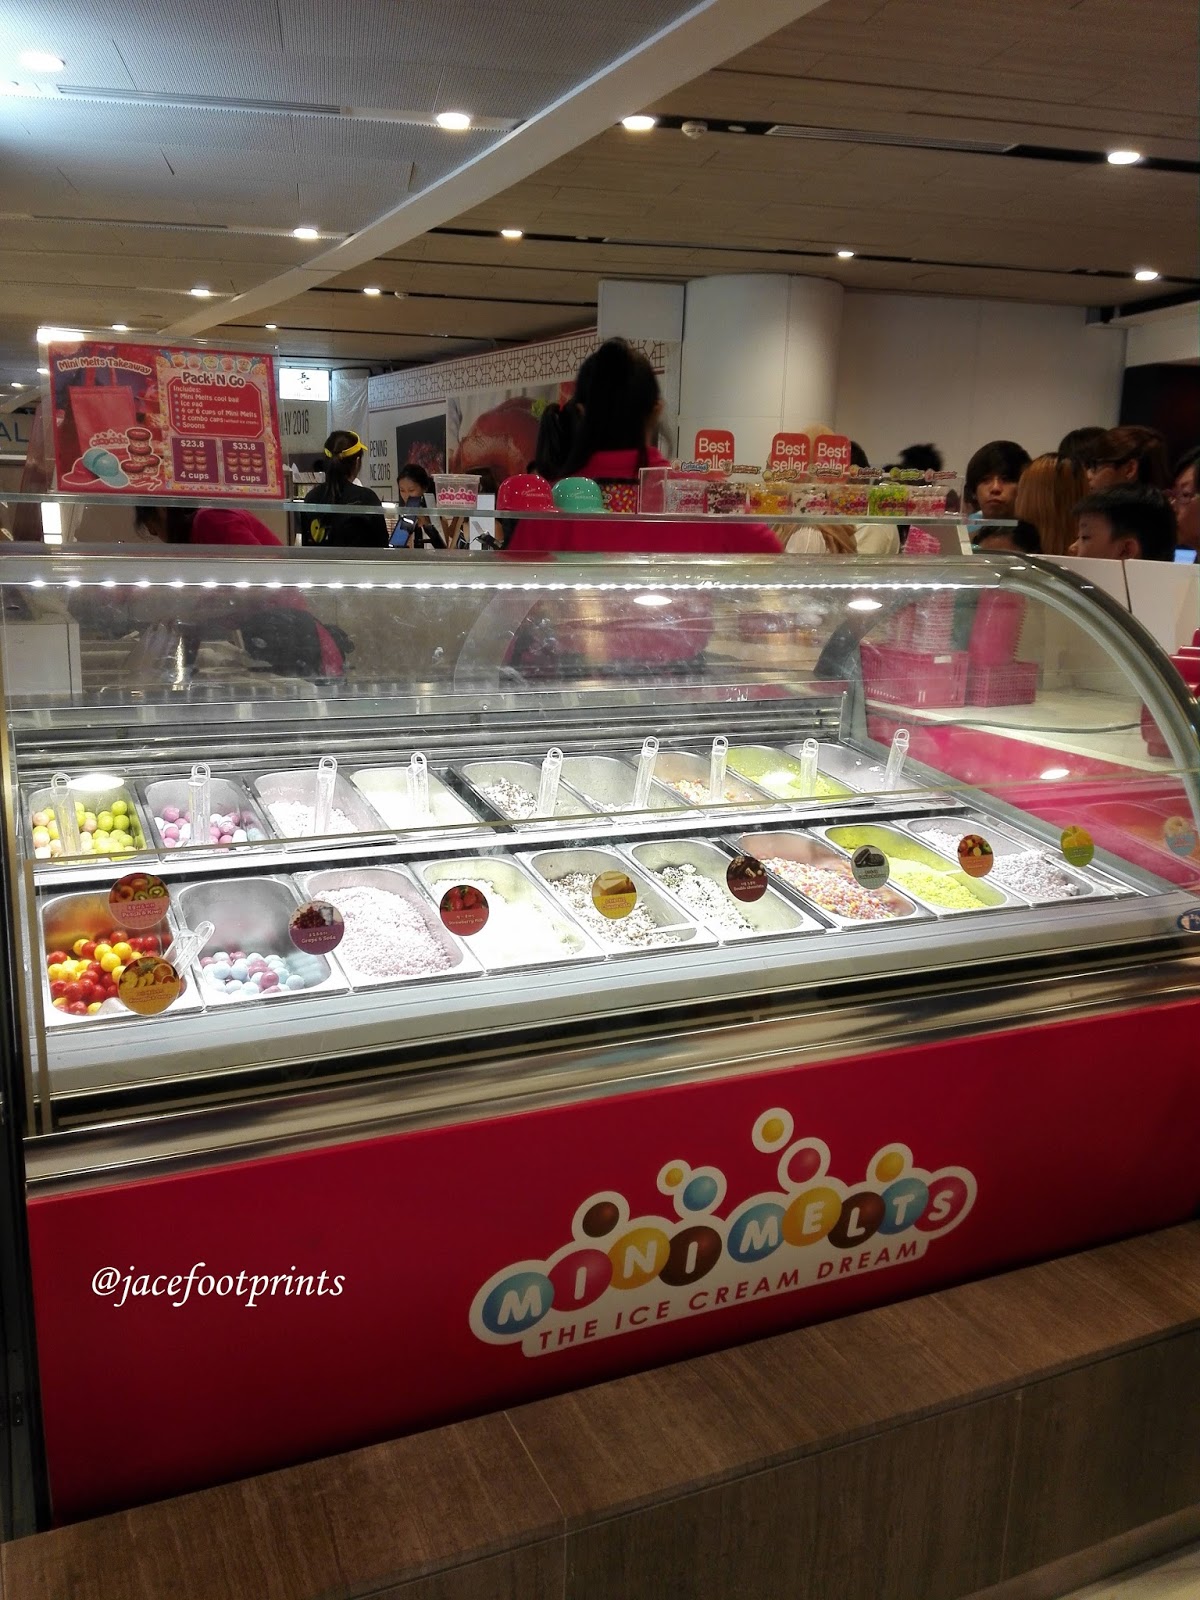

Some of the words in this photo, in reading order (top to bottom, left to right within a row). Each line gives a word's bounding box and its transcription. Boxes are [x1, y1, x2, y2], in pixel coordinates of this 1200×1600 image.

[58, 359, 79, 371] Mini
[80, 357, 105, 367] Melts
[106, 357, 151, 374] Takeaway
[216, 374, 226, 386] N
[228, 375, 245, 387] Go
[195, 394, 213, 402] Melts
[240, 411, 257, 419] Melts
[293, 409, 310, 436] 2016
[182, 421, 206, 429] Spoons
[180, 439, 205, 448] $23.8
[232, 441, 256, 451] $33.8
[698, 437, 731, 453] Best
[775, 440, 807, 456] Best
[817, 443, 847, 458] Best
[377, 462, 391, 481] 2016
[772, 457, 808, 472] seller
[180, 471, 187, 479] 4
[188, 472, 209, 481] cups
[232, 473, 239, 481] 6
[240, 475, 261, 483] cups
[495, 1236, 703, 1328] MINI
[741, 1187, 957, 1253] MELTS
[539, 1318, 599, 1351] THE
[614, 1300, 671, 1332] ICE
[687, 1268, 800, 1312] CREAM
[816, 1239, 918, 1280] DREAM
